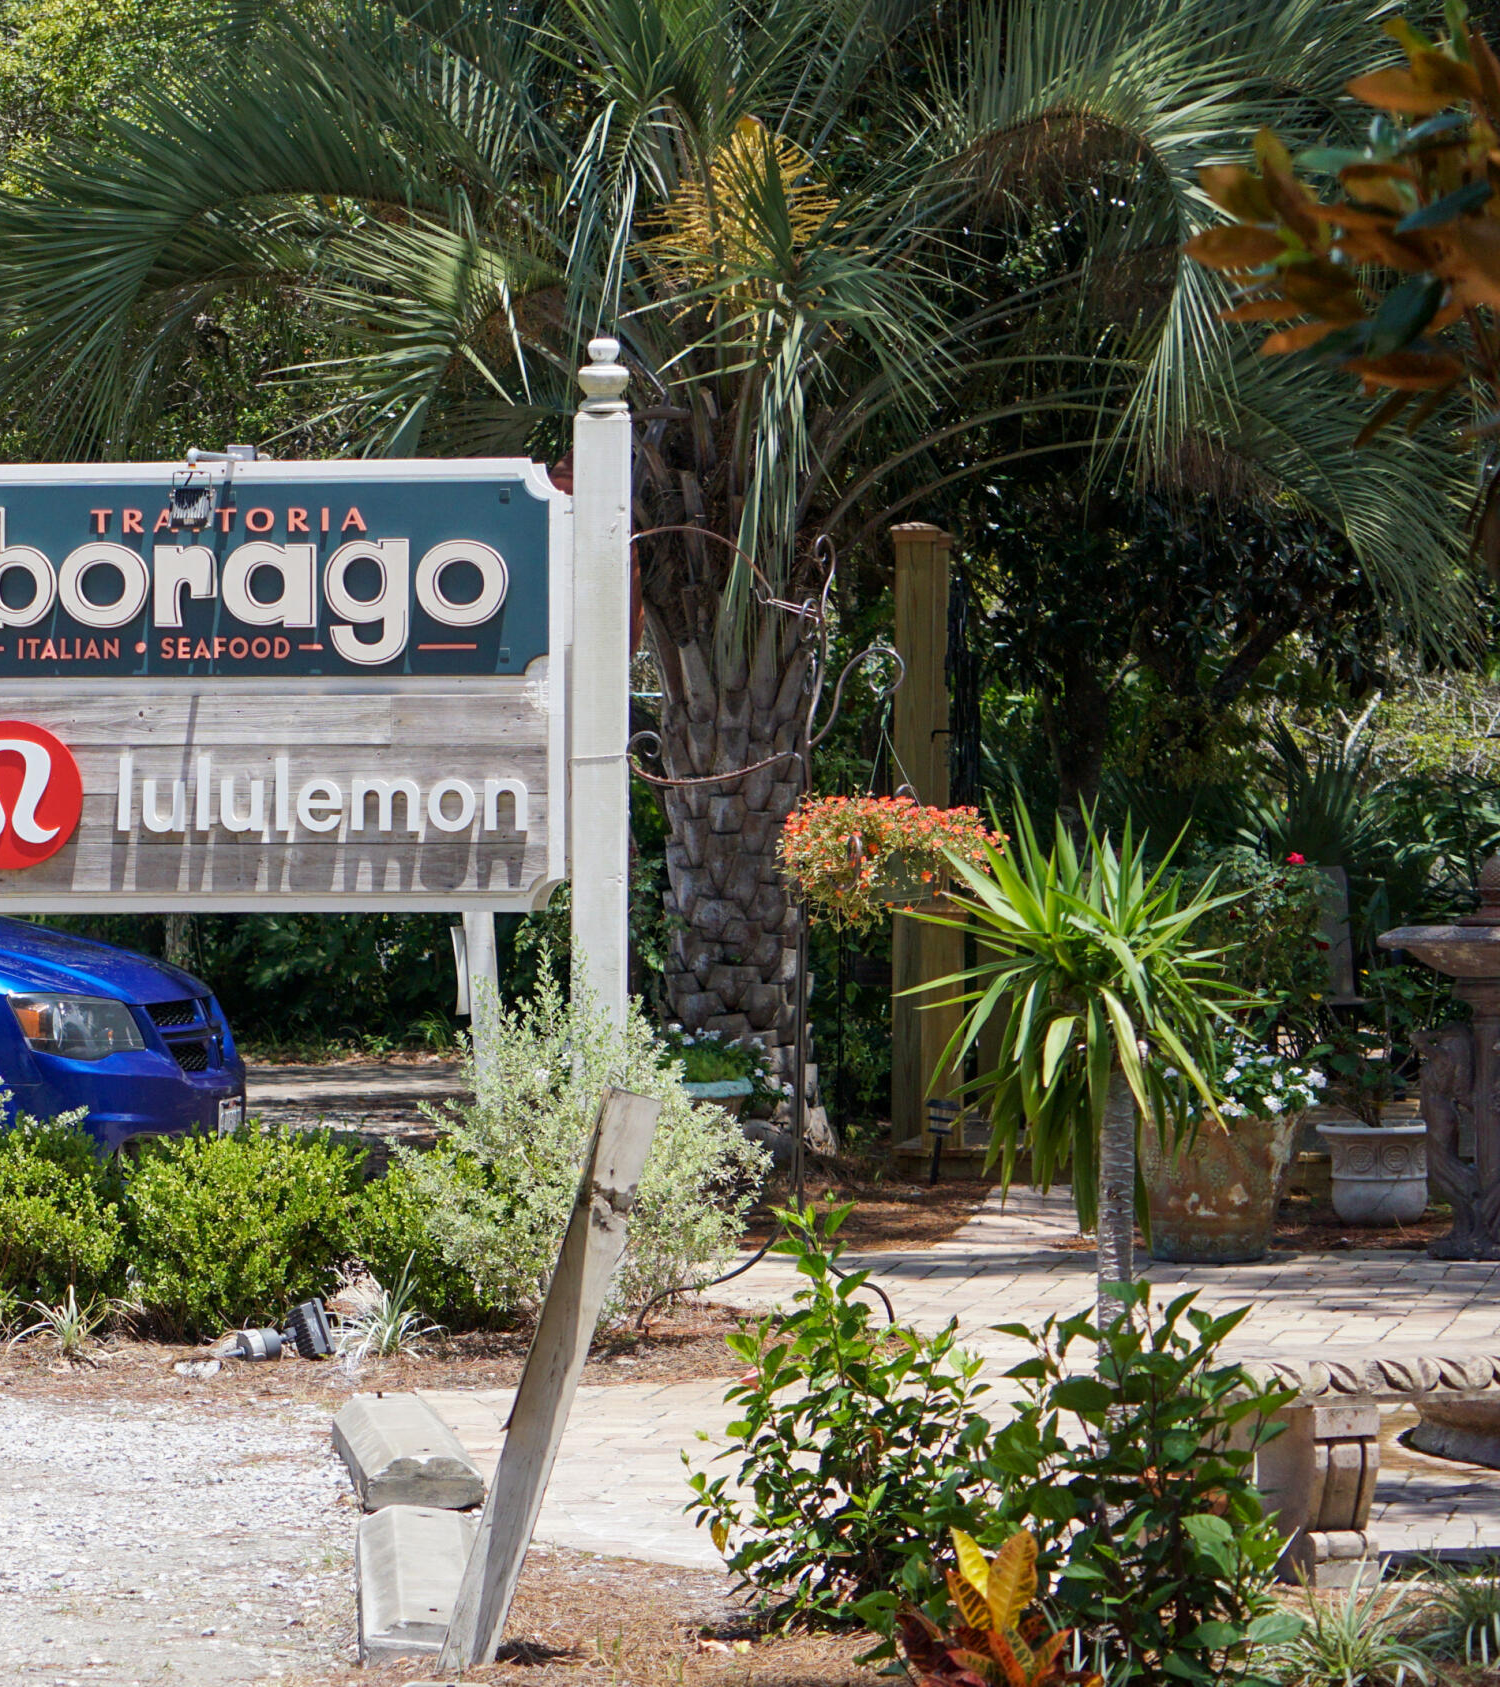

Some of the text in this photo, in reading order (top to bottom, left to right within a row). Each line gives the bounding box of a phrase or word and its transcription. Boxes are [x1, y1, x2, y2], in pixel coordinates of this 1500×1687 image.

[89, 507, 368, 534] TRATORIA
[17, 636, 291, 660] ITALIAN SEAFOOD
[116, 756, 529, 833] lululemon
